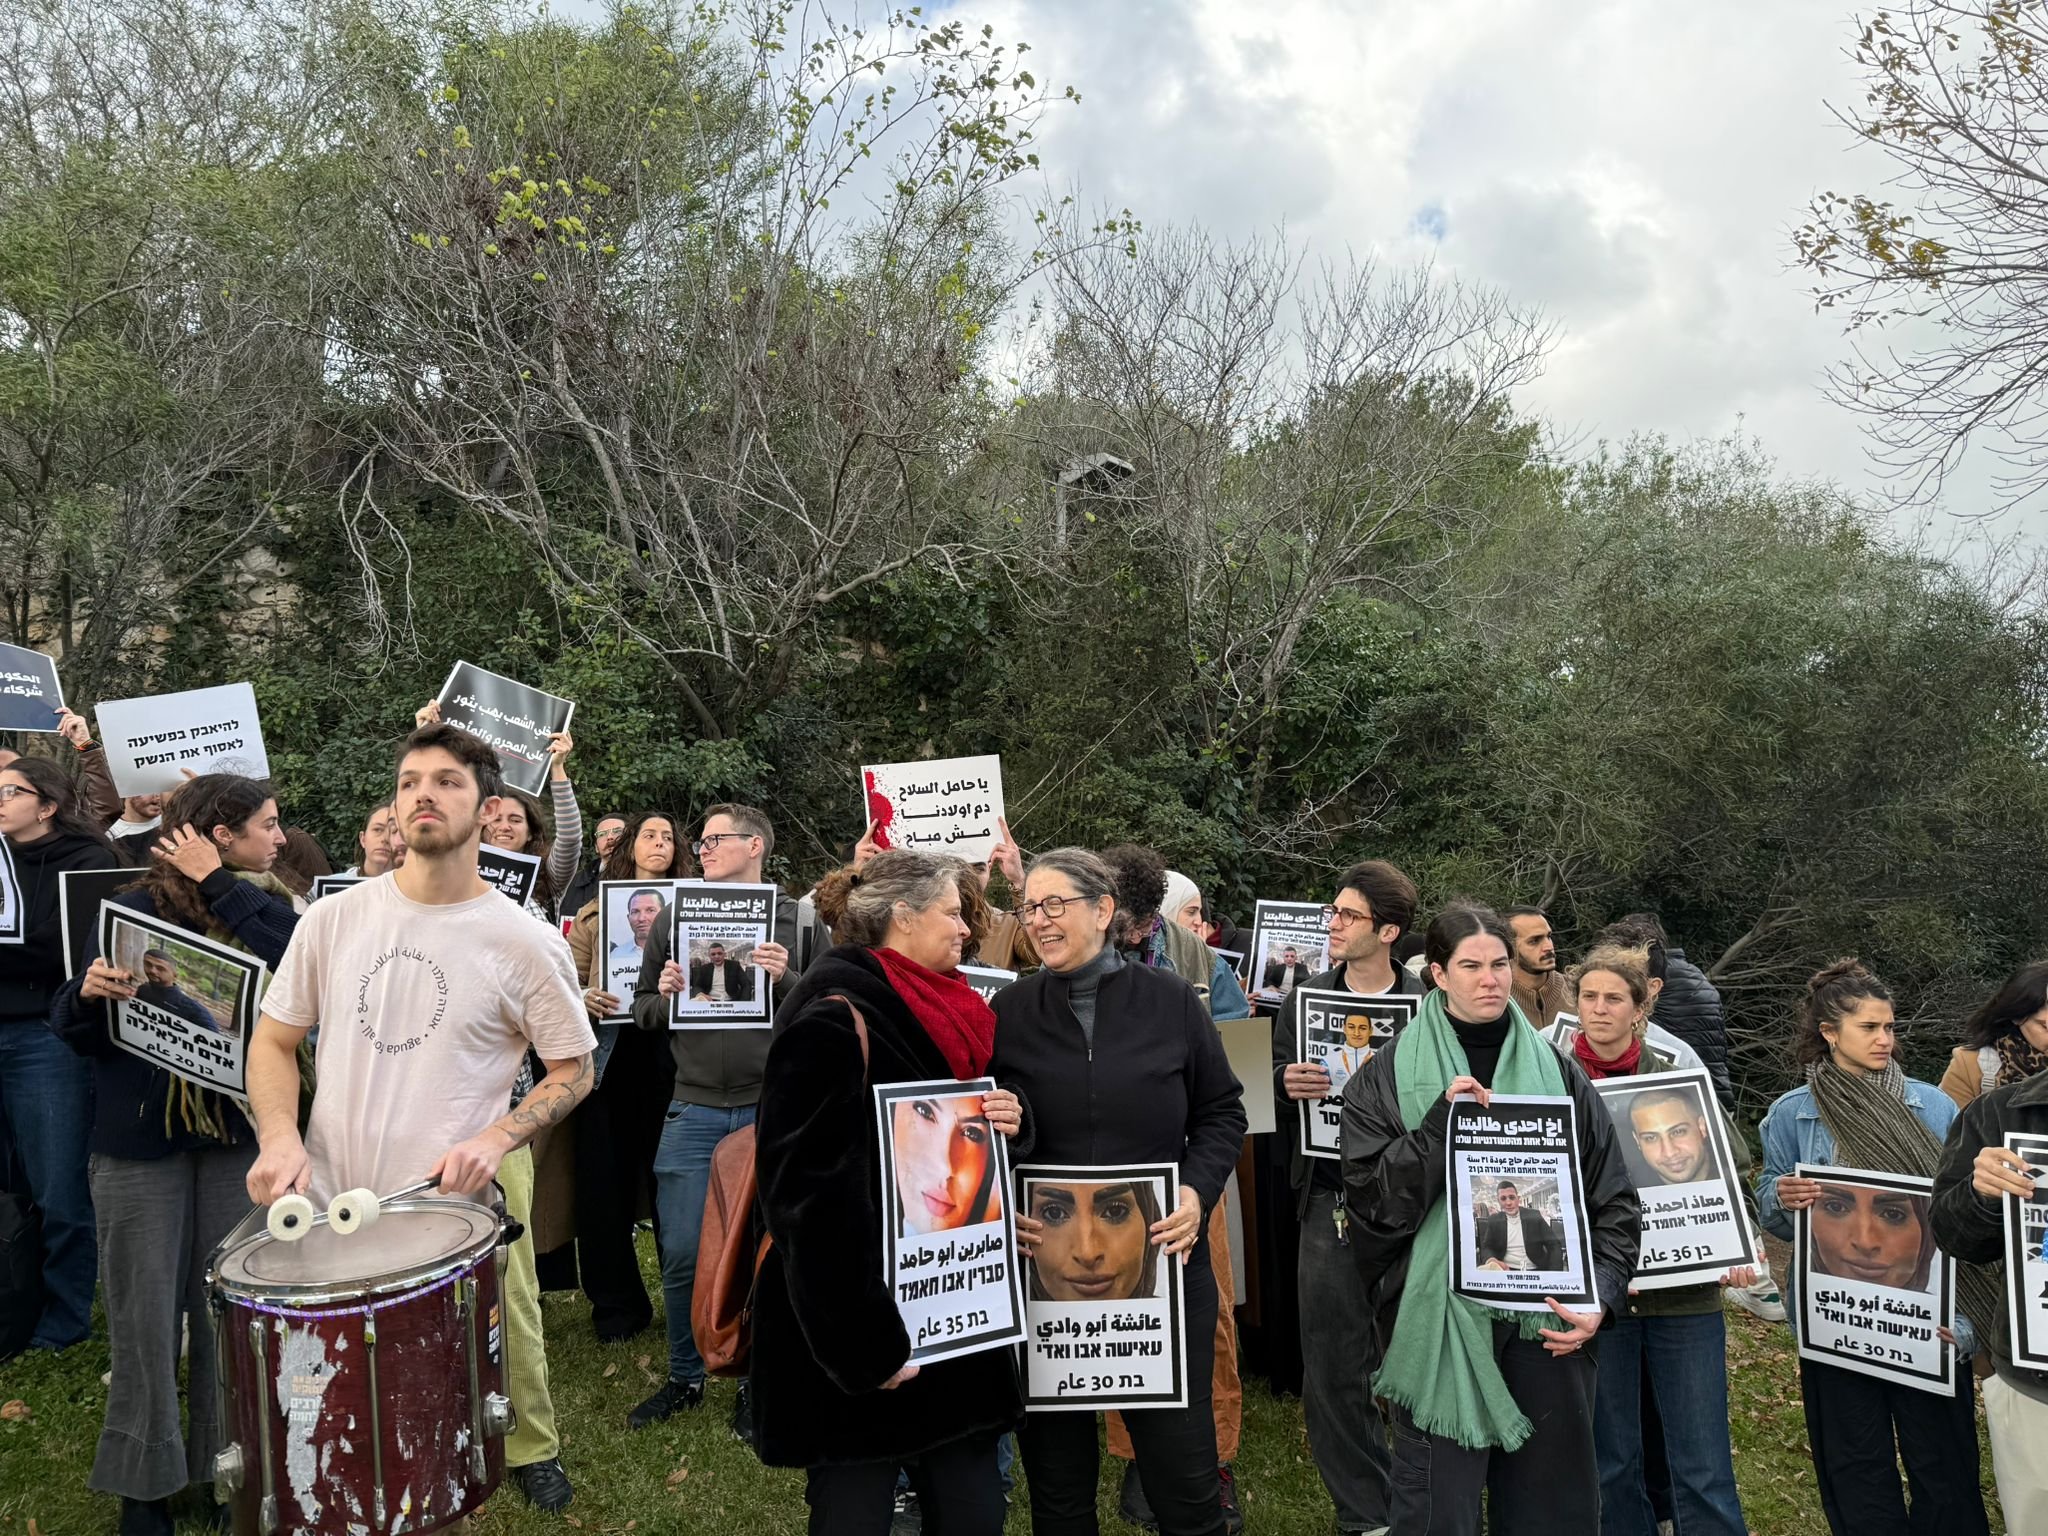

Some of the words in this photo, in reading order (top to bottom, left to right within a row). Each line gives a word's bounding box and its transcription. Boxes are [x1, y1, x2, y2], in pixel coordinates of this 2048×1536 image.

[4, 684, 43, 697] شركاء
[453, 695, 478, 712] يثور
[479, 705, 503, 721] يهب
[190, 720, 239, 740] להיאבק
[504, 715, 534, 732] الشعب
[127, 730, 186, 748] בפשיעה
[492, 738, 527, 754] المجرم
[180, 748, 200, 759] את
[204, 739, 243, 756] לאסוף
[134, 752, 175, 768] הנשק
[526, 752, 544, 761] على
[899, 782, 938, 801] السلاح
[941, 780, 975, 795] حامل
[978, 778, 988, 793] يا
[901, 804, 971, 819] اولادنا
[974, 802, 990, 819] دم
[906, 832, 941, 848] مباح
[945, 825, 990, 843] مش
[505, 871, 523, 886] اخ
[683, 898, 718, 910] طالبتنا
[721, 899, 751, 911] احدى
[753, 899, 766, 912] اخ
[432, 966, 448, 995] לכולנו
[129, 1000, 188, 1034] خلايلة
[428, 999, 446, 1030] אגודה
[362, 1025, 376, 1041] all
[146, 1043, 170, 1056] عام
[194, 1034, 231, 1053] آدم
[386, 1037, 422, 1055] aguda
[175, 1055, 194, 1067] 20
[199, 1048, 234, 1070] אדם
[200, 1064, 215, 1076] בן
[1458, 1116, 1501, 1134] طالبتنا
[1504, 1118, 1543, 1135] احدى
[1546, 1118, 1562, 1137] اخ
[1456, 1134, 1471, 1144] שלנו
[1473, 1136, 1522, 1145] מהסטודנטיות
[1524, 1137, 1540, 1145] אחת
[1542, 1137, 1554, 1146] של
[1490, 1156, 1507, 1165] عودة
[1509, 1157, 1522, 1165] حاج
[1654, 1198, 1688, 1213] احمد
[1692, 1195, 1725, 1208] معاذ
[1652, 1216, 1686, 1229] אחמד
[1687, 1211, 1730, 1225] מועאד'
[938, 1241, 954, 1267] ابو
[958, 1234, 1003, 1262] صابرين
[1672, 1246, 1691, 1262] 36
[1695, 1245, 1713, 1260] בן
[900, 1247, 934, 1270] حامد
[1643, 1248, 1668, 1268] عام
[942, 1270, 964, 1293] אבו
[968, 1263, 1004, 1291] סברין
[899, 1276, 939, 1302] חאמד
[1816, 1291, 1855, 1308] وادي
[1859, 1296, 1879, 1312] أبو
[1816, 1306, 1845, 1323] ואדי
[1883, 1299, 1931, 1320] عائشة
[946, 1316, 964, 1335] 35
[967, 1310, 989, 1328] בת
[1086, 1314, 1106, 1337] أبو
[1111, 1313, 1161, 1332] عائشة
[1849, 1314, 1873, 1330] אבו
[918, 1317, 941, 1346] عام
[1037, 1318, 1081, 1341] وادي
[1877, 1320, 1931, 1341] עאישה
[1074, 1342, 1101, 1358] אבו
[1106, 1341, 1162, 1357] עאישה
[1834, 1335, 1859, 1350] عام
[1864, 1343, 1884, 1356] 30
[1037, 1344, 1070, 1359] ואדי
[1889, 1349, 1914, 1364] בת
[1058, 1372, 1086, 1395] عام
[1091, 1376, 1113, 1391] 30
[1119, 1374, 1144, 1388] בת
